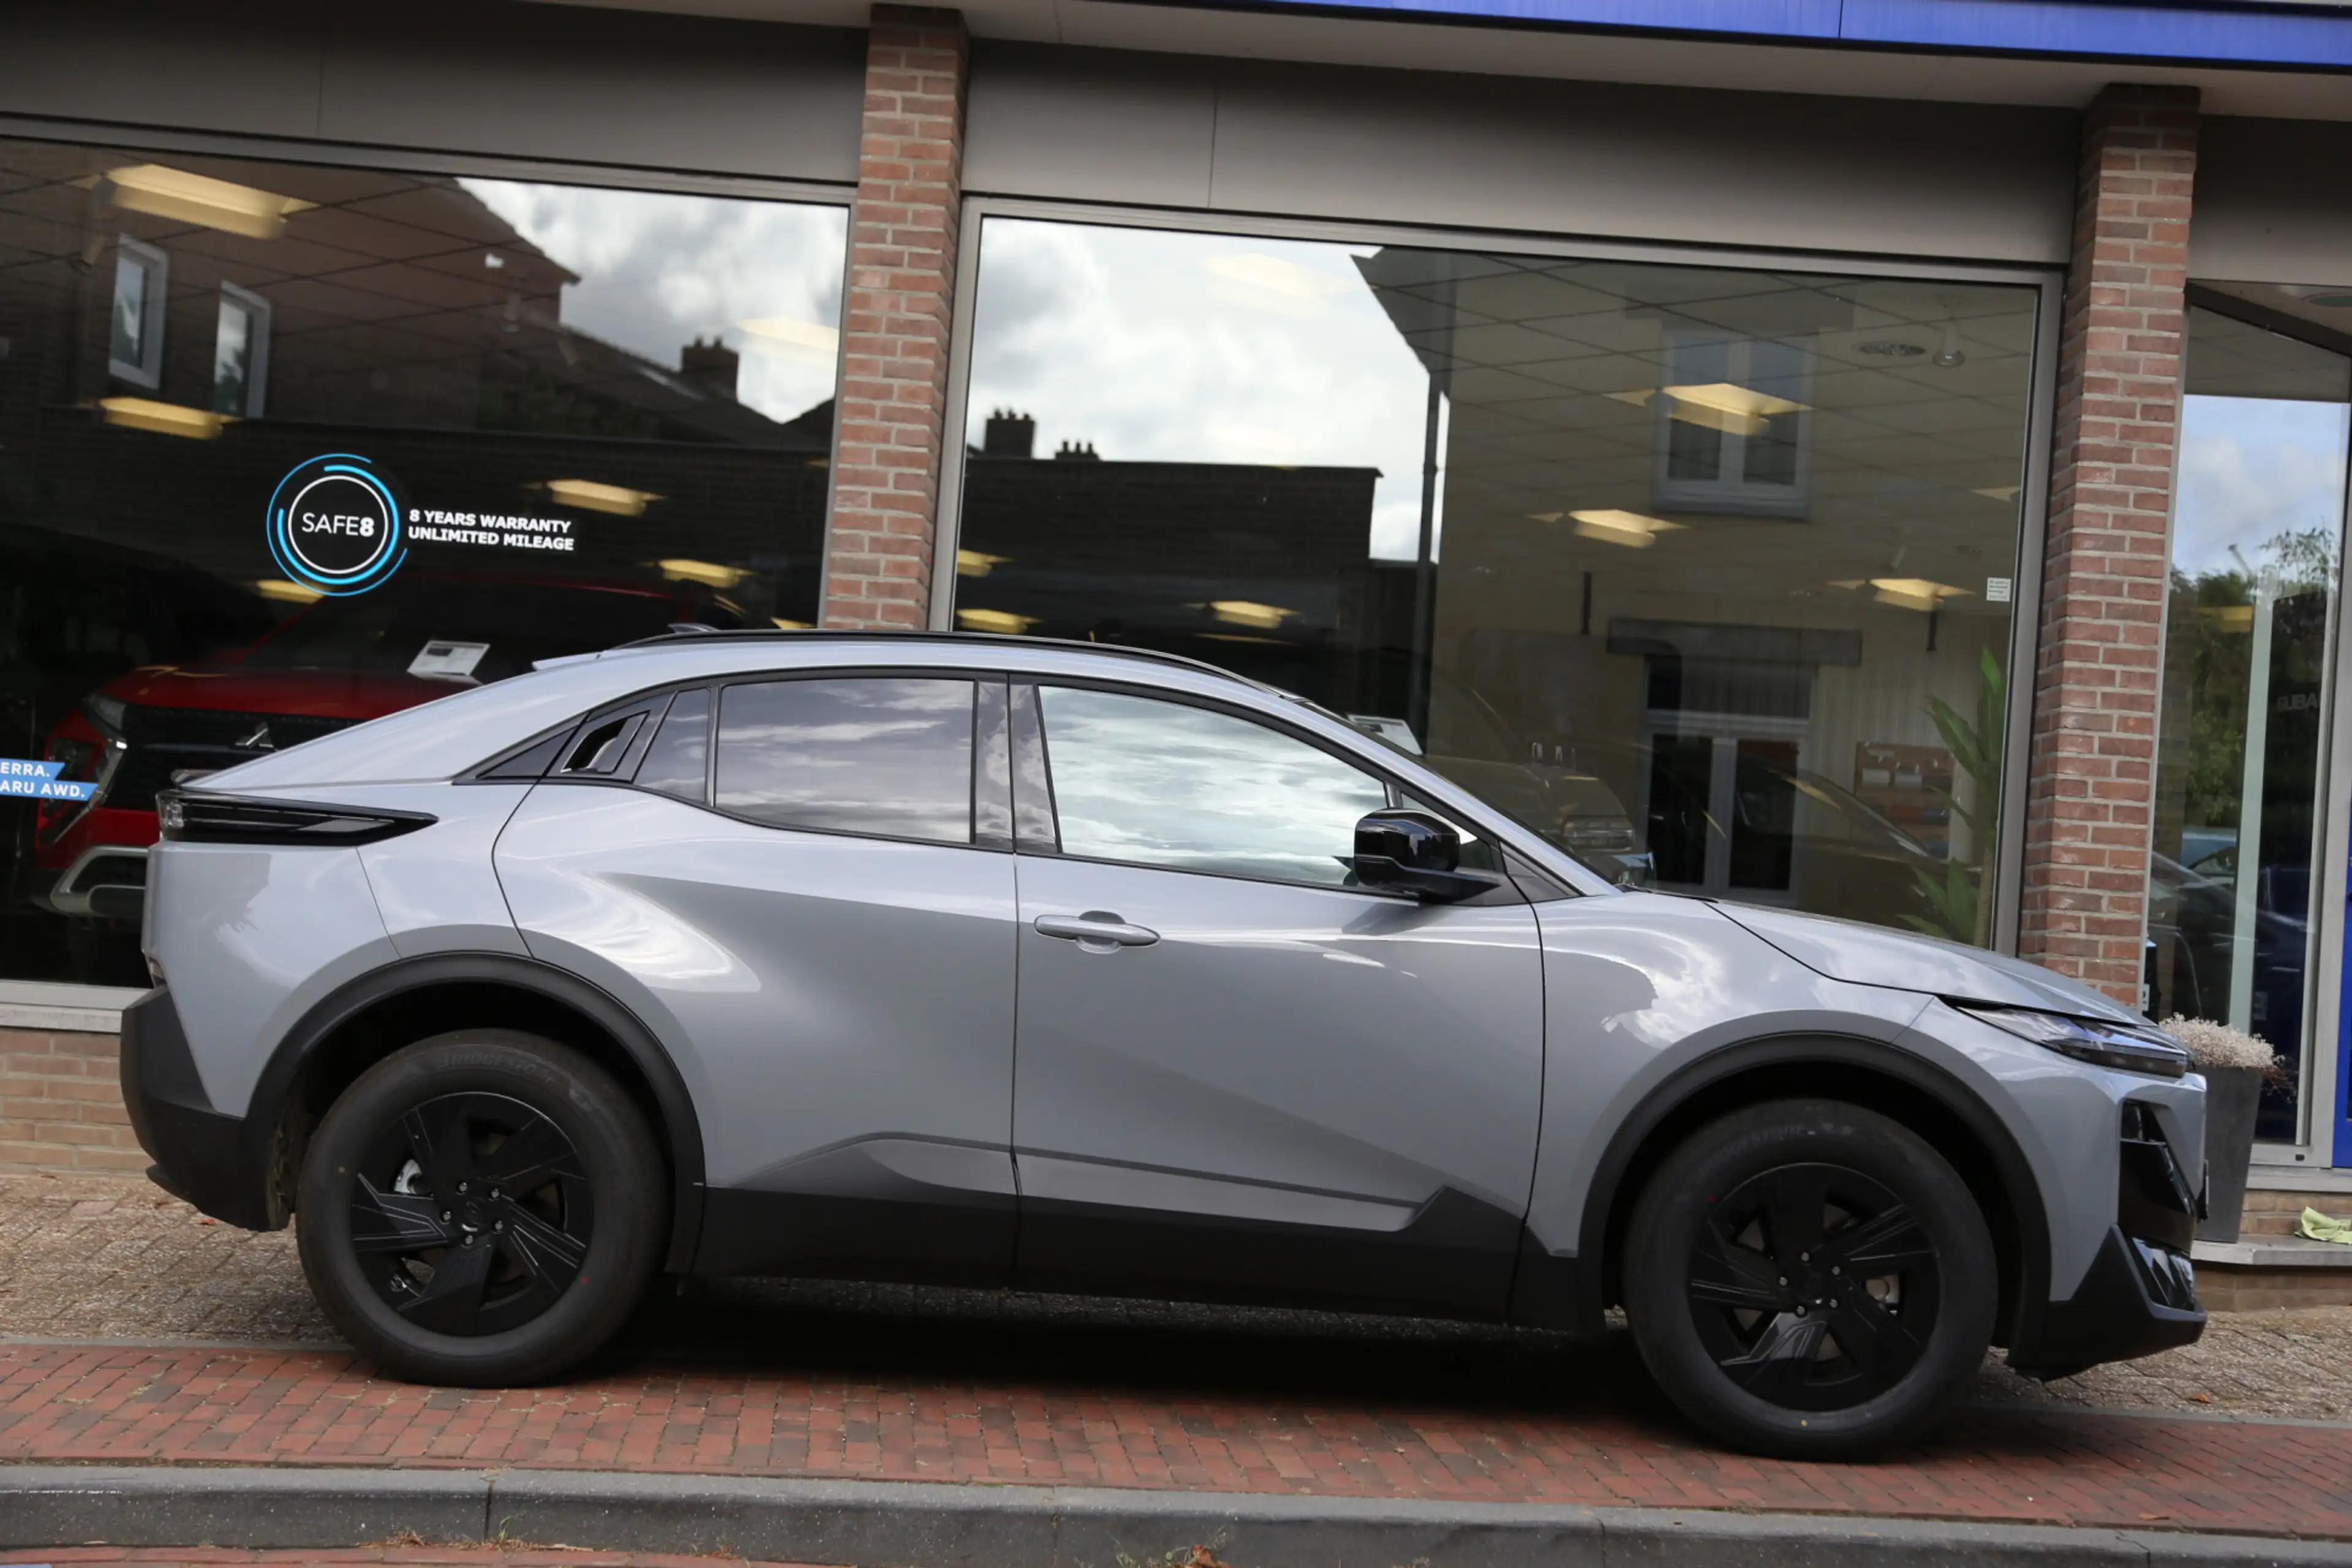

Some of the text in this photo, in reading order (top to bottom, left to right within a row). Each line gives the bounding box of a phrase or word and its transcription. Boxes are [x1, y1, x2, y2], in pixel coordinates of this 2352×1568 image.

[301, 512, 374, 537] SAFE8
[409, 509, 571, 533] 8 YEARS WARRANTY
[408, 526, 575, 551] UNLIMITED MILEAGE
[40, 783, 85, 798] AWD.
